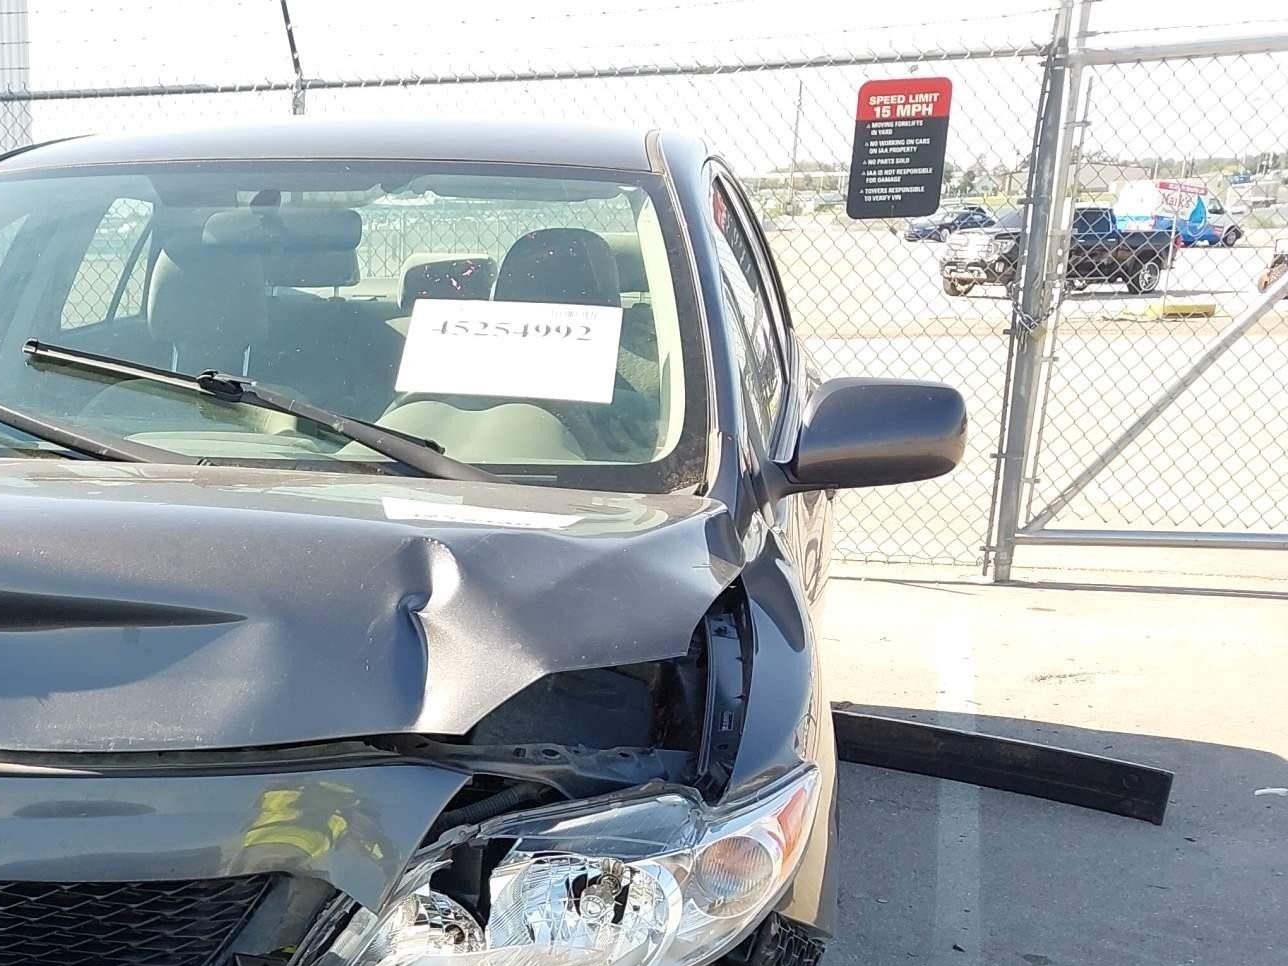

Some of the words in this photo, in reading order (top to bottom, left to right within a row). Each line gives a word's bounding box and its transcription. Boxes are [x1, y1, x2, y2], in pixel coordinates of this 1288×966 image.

[869, 95, 906, 105] SPEED
[908, 92, 940, 103] LIMIT
[874, 106, 891, 118] 15
[896, 103, 934, 117] MPH
[871, 121, 894, 129] MOVING
[896, 167, 933, 175] RESPONSIBLE
[431, 320, 592, 341] 45254992
